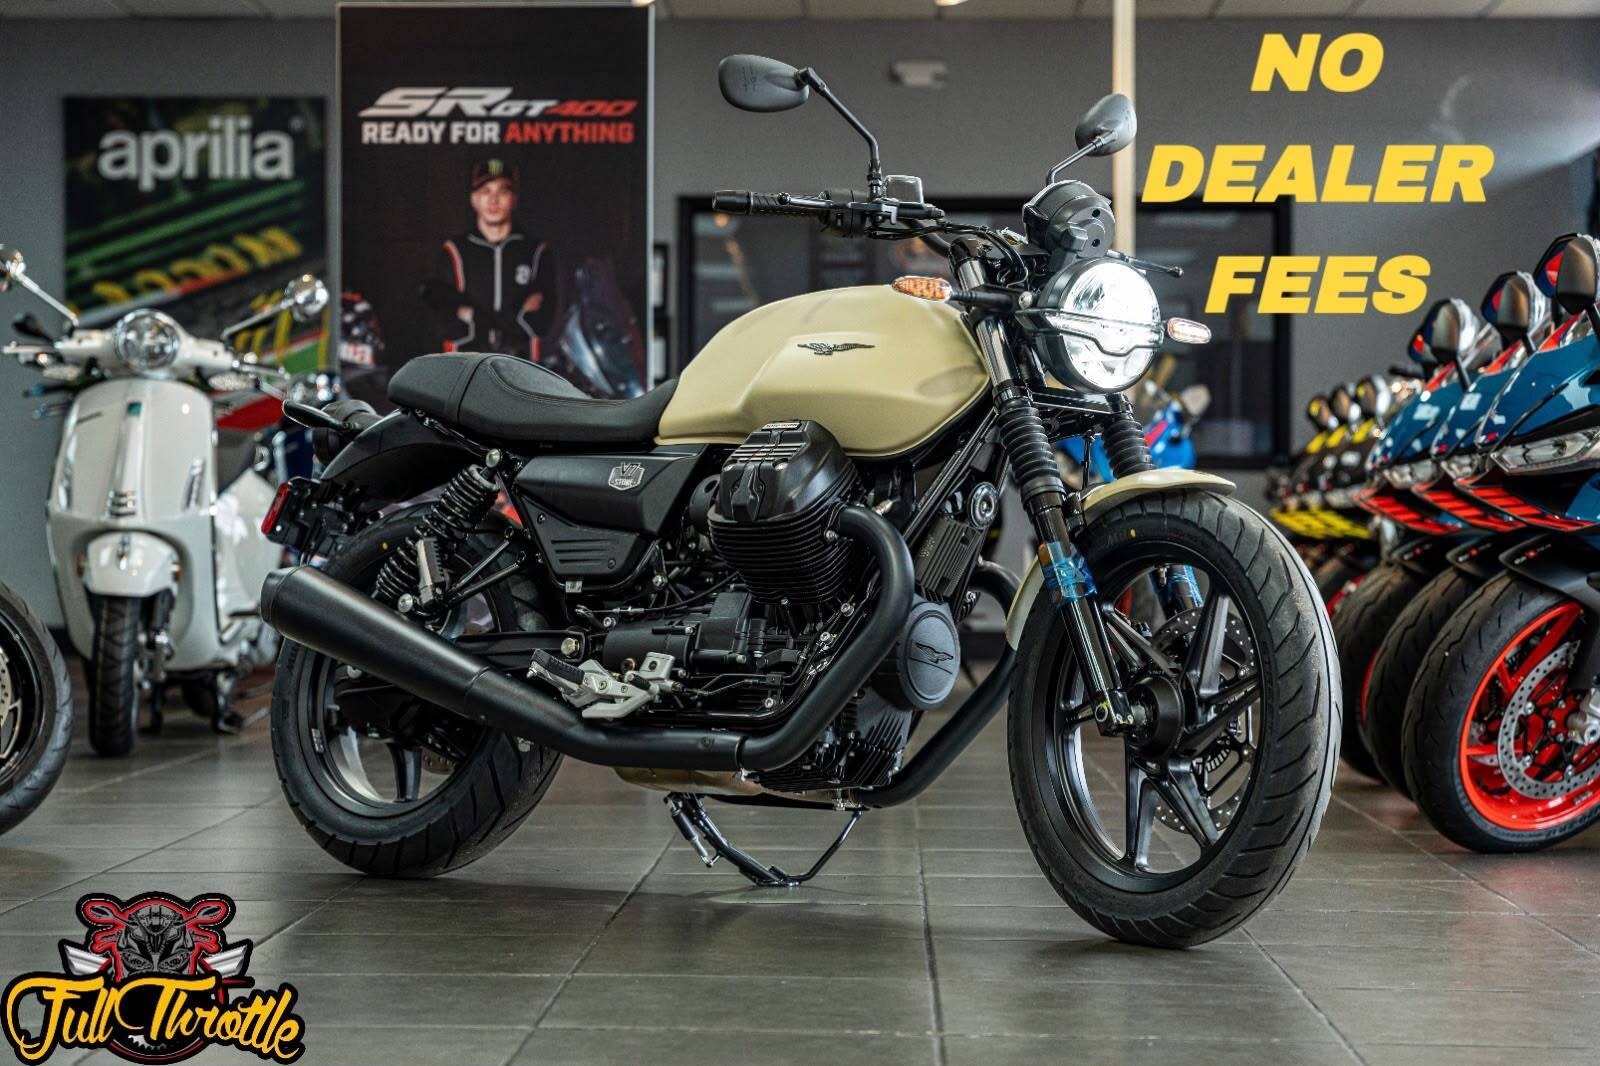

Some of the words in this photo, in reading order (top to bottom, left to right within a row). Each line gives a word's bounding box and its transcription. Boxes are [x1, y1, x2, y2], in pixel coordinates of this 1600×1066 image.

[97, 115, 294, 192] aprilia
[362, 121, 445, 144] READY
[451, 121, 500, 144] FOR
[505, 121, 634, 144] ANYTHING
